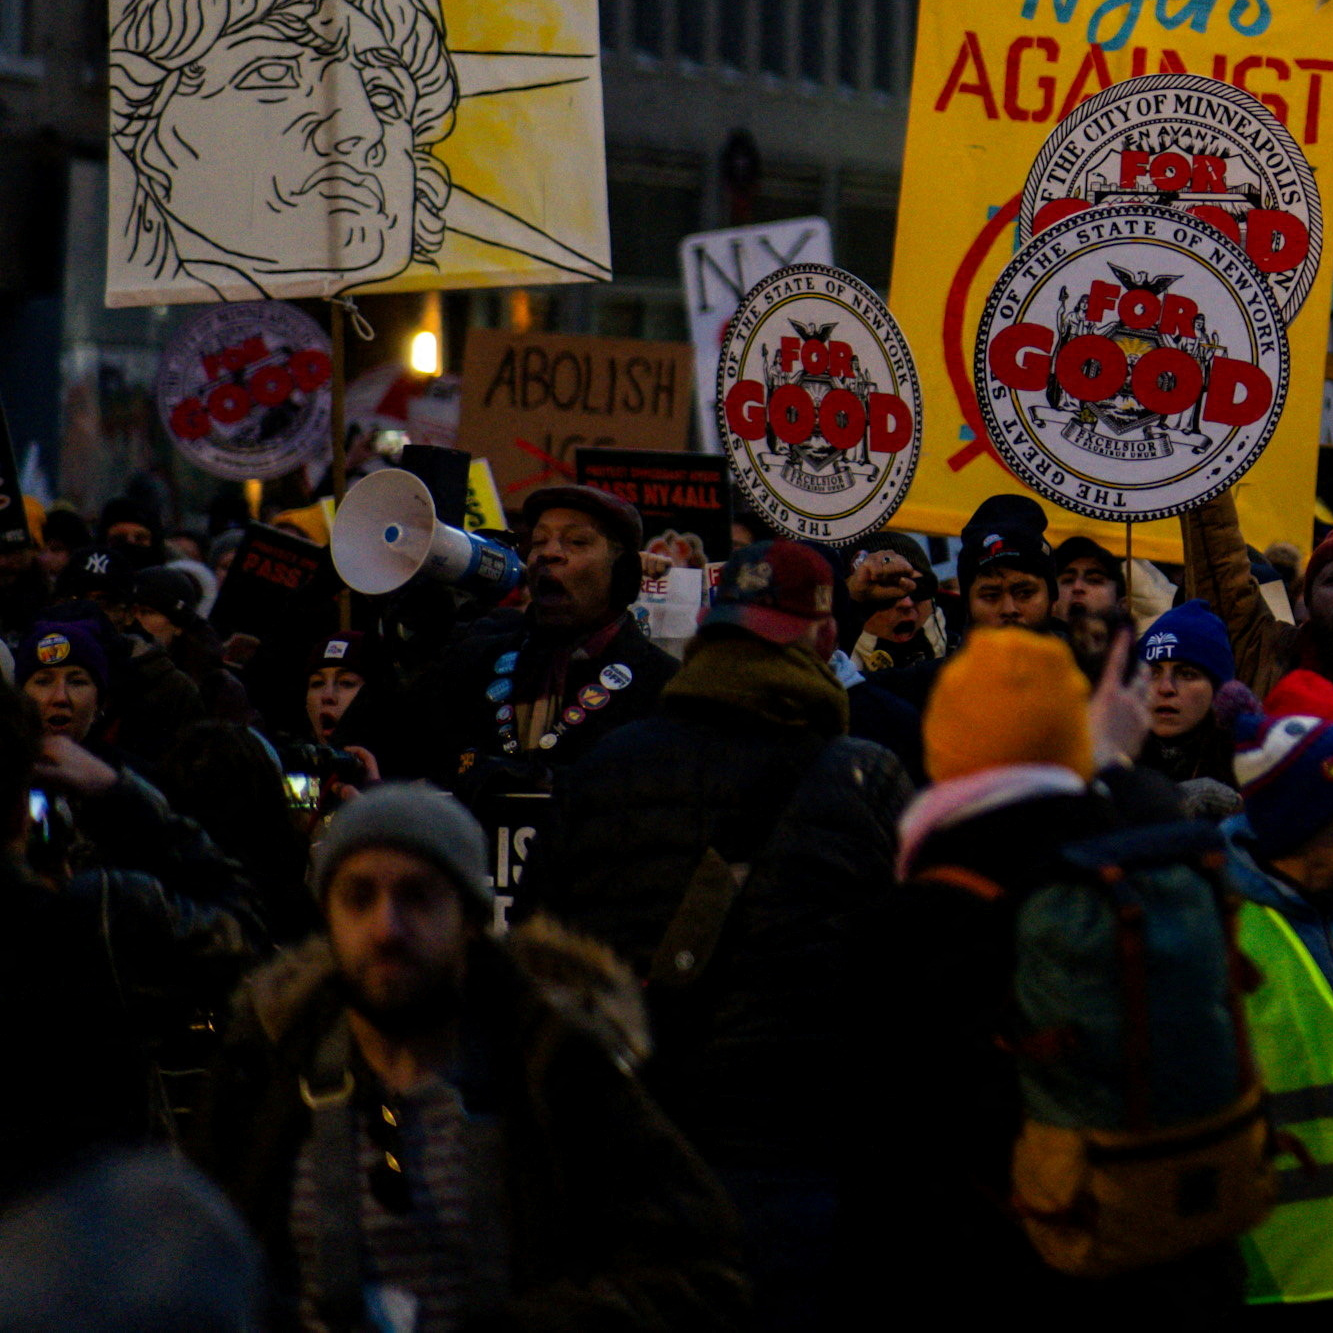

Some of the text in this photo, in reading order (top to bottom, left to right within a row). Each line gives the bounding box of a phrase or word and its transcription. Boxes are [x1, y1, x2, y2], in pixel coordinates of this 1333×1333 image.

[1047, 140, 1085, 185] THE
[1083, 101, 1132, 143] CITY
[1137, 94, 1167, 116] OF
[1173, 93, 1301, 206] MINNEAPOLIS
[1157, 125, 1221, 145] AVANT
[1120, 150, 1228, 193] FOR
[1000, 290, 1021, 319] OF
[1023, 243, 1066, 280] THE
[1076, 220, 1157, 244] STATE
[1174, 228, 1203, 247] OF
[1209, 247, 1252, 290] NEW
[1249, 293, 1276, 355] YORK
[1085, 279, 1199, 338] FOR
[727, 276, 909, 387] OF THE STATE OF NEW YORK
[482, 344, 677, 418] ABOLISH
[780, 336, 856, 379] FOR
[988, 322, 1274, 426] GOOD
[170, 349, 332, 440] GOOD
[724, 379, 913, 454] GOOD
[1003, 418, 1127, 507] THE GREAT
[1078, 428, 1157, 452] EXCELSIOR
[642, 481, 725, 510] NY4ALL
[792, 471, 844, 487] EXCELSIOR
[798, 521, 832, 536] THE
[641, 579, 668, 595] REE
[1146, 645, 1176, 661] UFT
